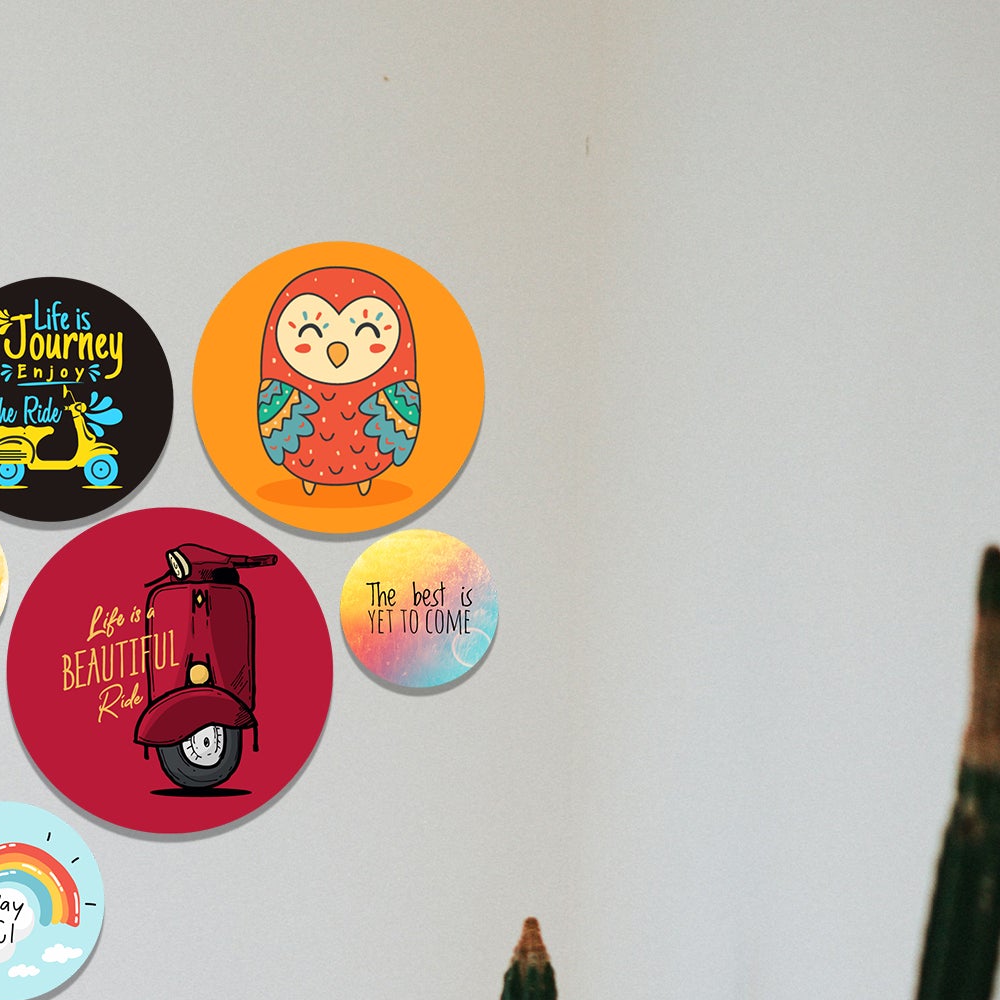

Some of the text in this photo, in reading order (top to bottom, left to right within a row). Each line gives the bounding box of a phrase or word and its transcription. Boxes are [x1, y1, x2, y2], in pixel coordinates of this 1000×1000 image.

[34, 298, 92, 331] Life is
[3, 313, 124, 380] Journey
[17, 363, 85, 383] Enjoy
[23, 395, 62, 425] Ride
[366, 581, 473, 607] The best is
[86, 605, 156, 642] Life is a
[367, 609, 471, 635] YET TO COME
[61, 629, 180, 692] BEAUTIFUL
[98, 682, 144, 723] Ride
